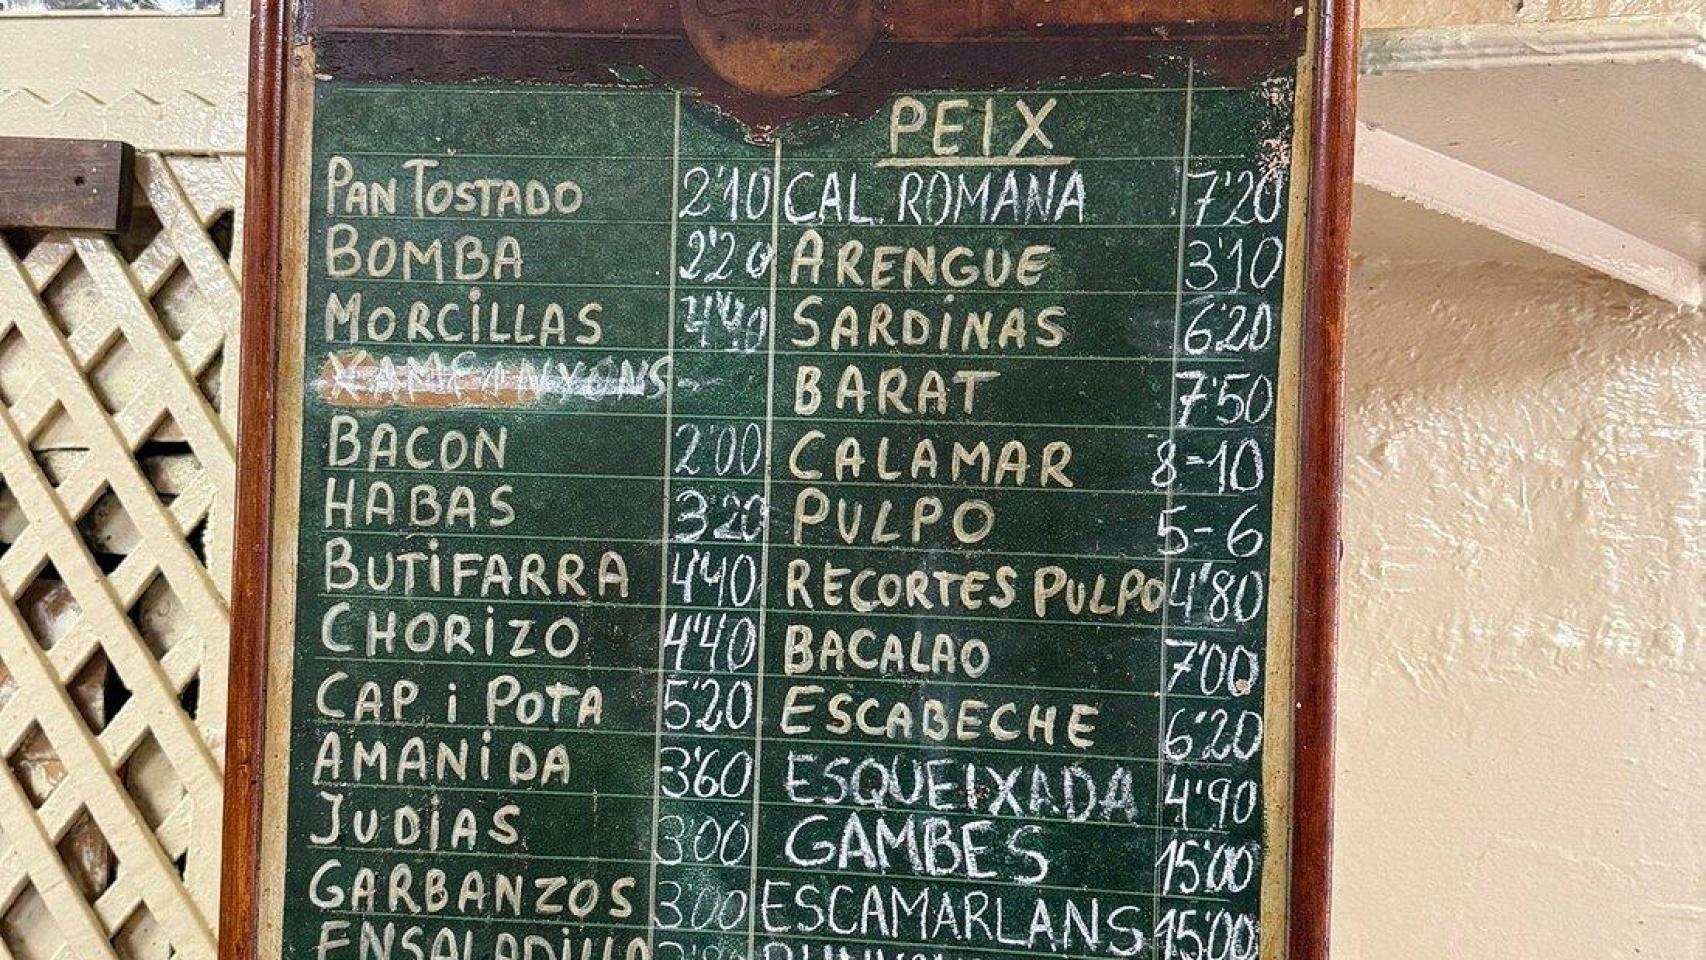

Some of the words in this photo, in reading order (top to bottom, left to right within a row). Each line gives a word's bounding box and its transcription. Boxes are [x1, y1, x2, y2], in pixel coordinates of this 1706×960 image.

[890, 96, 1057, 156] PEIX
[326, 155, 397, 216] PAN
[402, 159, 582, 217] TOSTADO
[679, 166, 771, 221] 2'10
[898, 168, 1087, 226] ROMANA
[1189, 168, 1282, 227] 7'20
[326, 223, 523, 281] BOMBA
[790, 228, 1053, 289] ARENGUE
[1185, 235, 1284, 294] 3'10
[1183, 300, 1274, 355] 6'20
[793, 364, 1001, 415] BARAT
[1176, 369, 1273, 428] 7'50
[329, 415, 507, 472] BACON
[674, 423, 762, 476] 2'00
[789, 429, 1074, 488] CALAMAR
[325, 477, 516, 528] HABAS
[793, 486, 995, 546] PULPO
[787, 558, 1018, 611] RECORTES
[1034, 565, 1166, 617] PULPO
[1169, 562, 1264, 623] 4'80
[664, 611, 757, 670] 4'40
[784, 625, 989, 677] BACALAO
[1164, 638, 1259, 697] 7'00
[317, 672, 419, 723] CAP
[486, 675, 602, 727] POTA
[663, 677, 753, 732] 5'20
[780, 685, 1099, 748] ESCABECHE
[1164, 708, 1263, 760] 6'20
[660, 746, 753, 799] 3'60
[785, 749, 1138, 826] ESQUEIXADA
[1165, 773, 1257, 831] 4'90
[785, 812, 1050, 886] GAMBES
[1156, 838, 1256, 895] 15'00
[310, 859, 636, 918] GARBANZOS
[761, 880, 1144, 956] ESCAMARLANS
